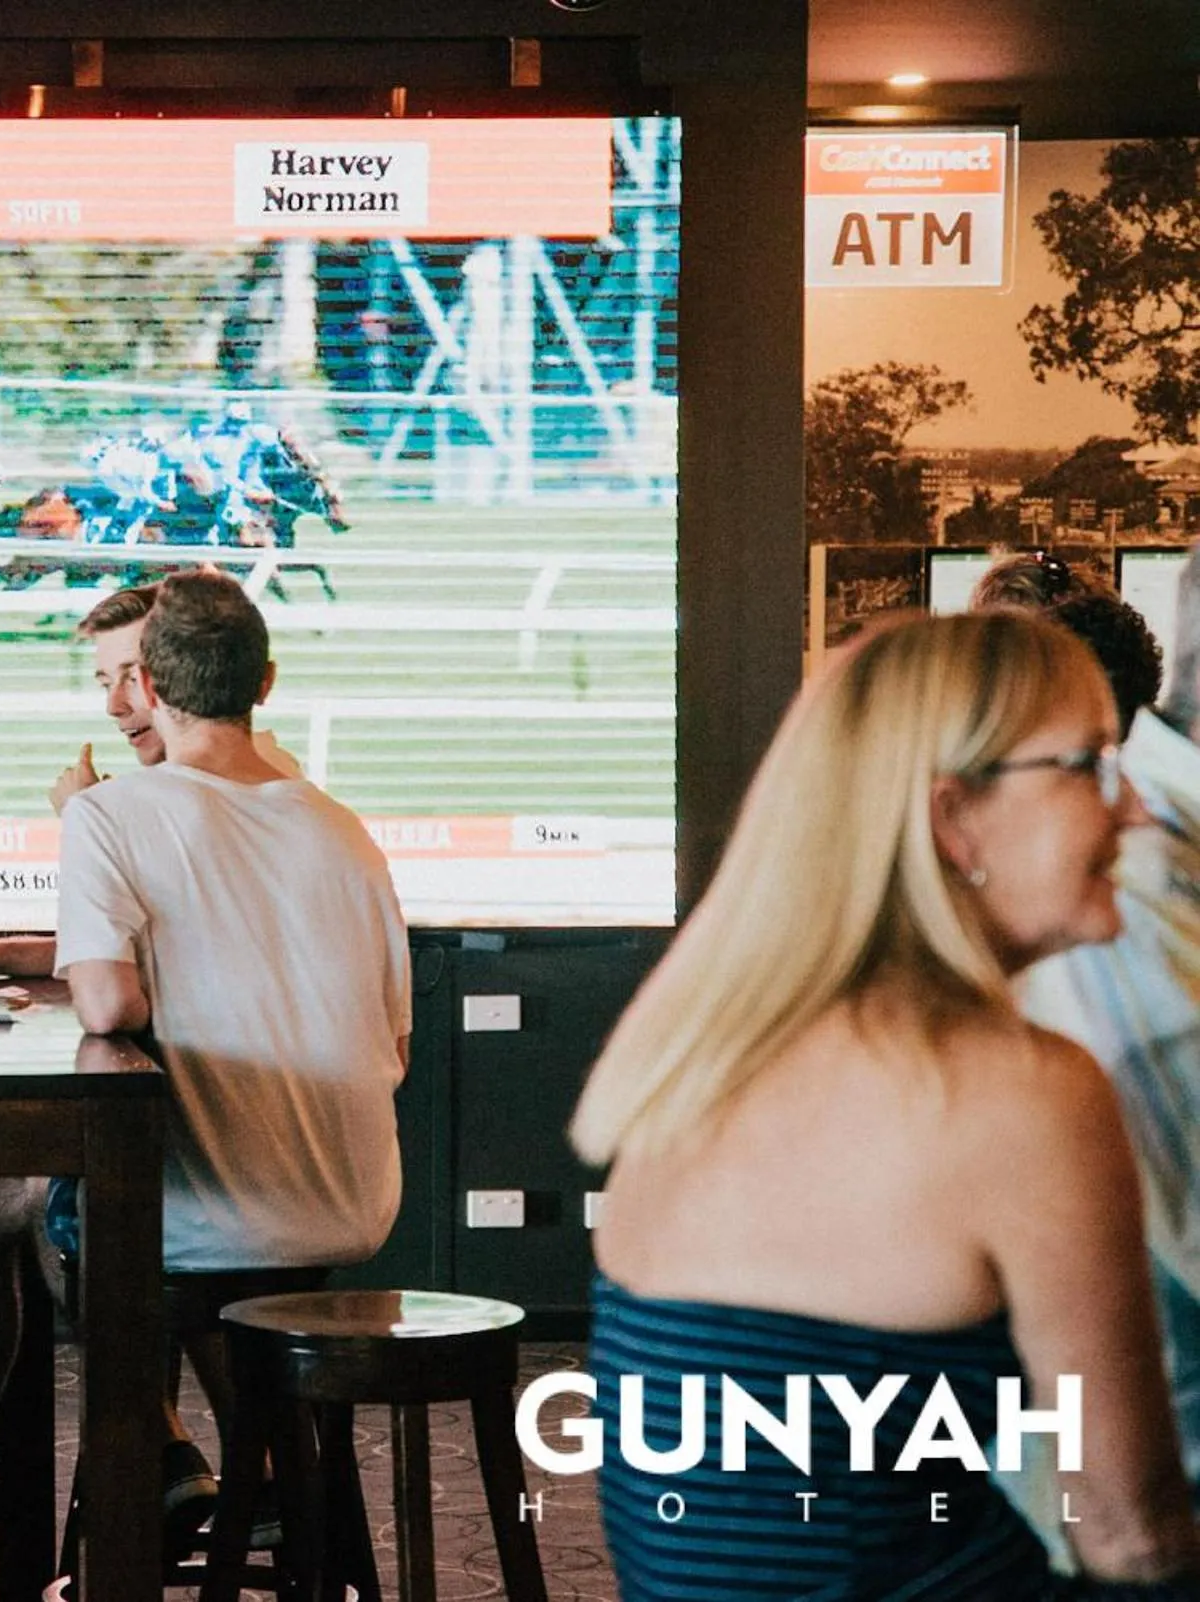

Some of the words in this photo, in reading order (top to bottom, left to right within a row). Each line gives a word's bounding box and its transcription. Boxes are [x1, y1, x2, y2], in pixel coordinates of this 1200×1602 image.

[270, 149, 393, 181] Harvey
[262, 185, 400, 213] Norman
[832, 211, 973, 266] ATM
